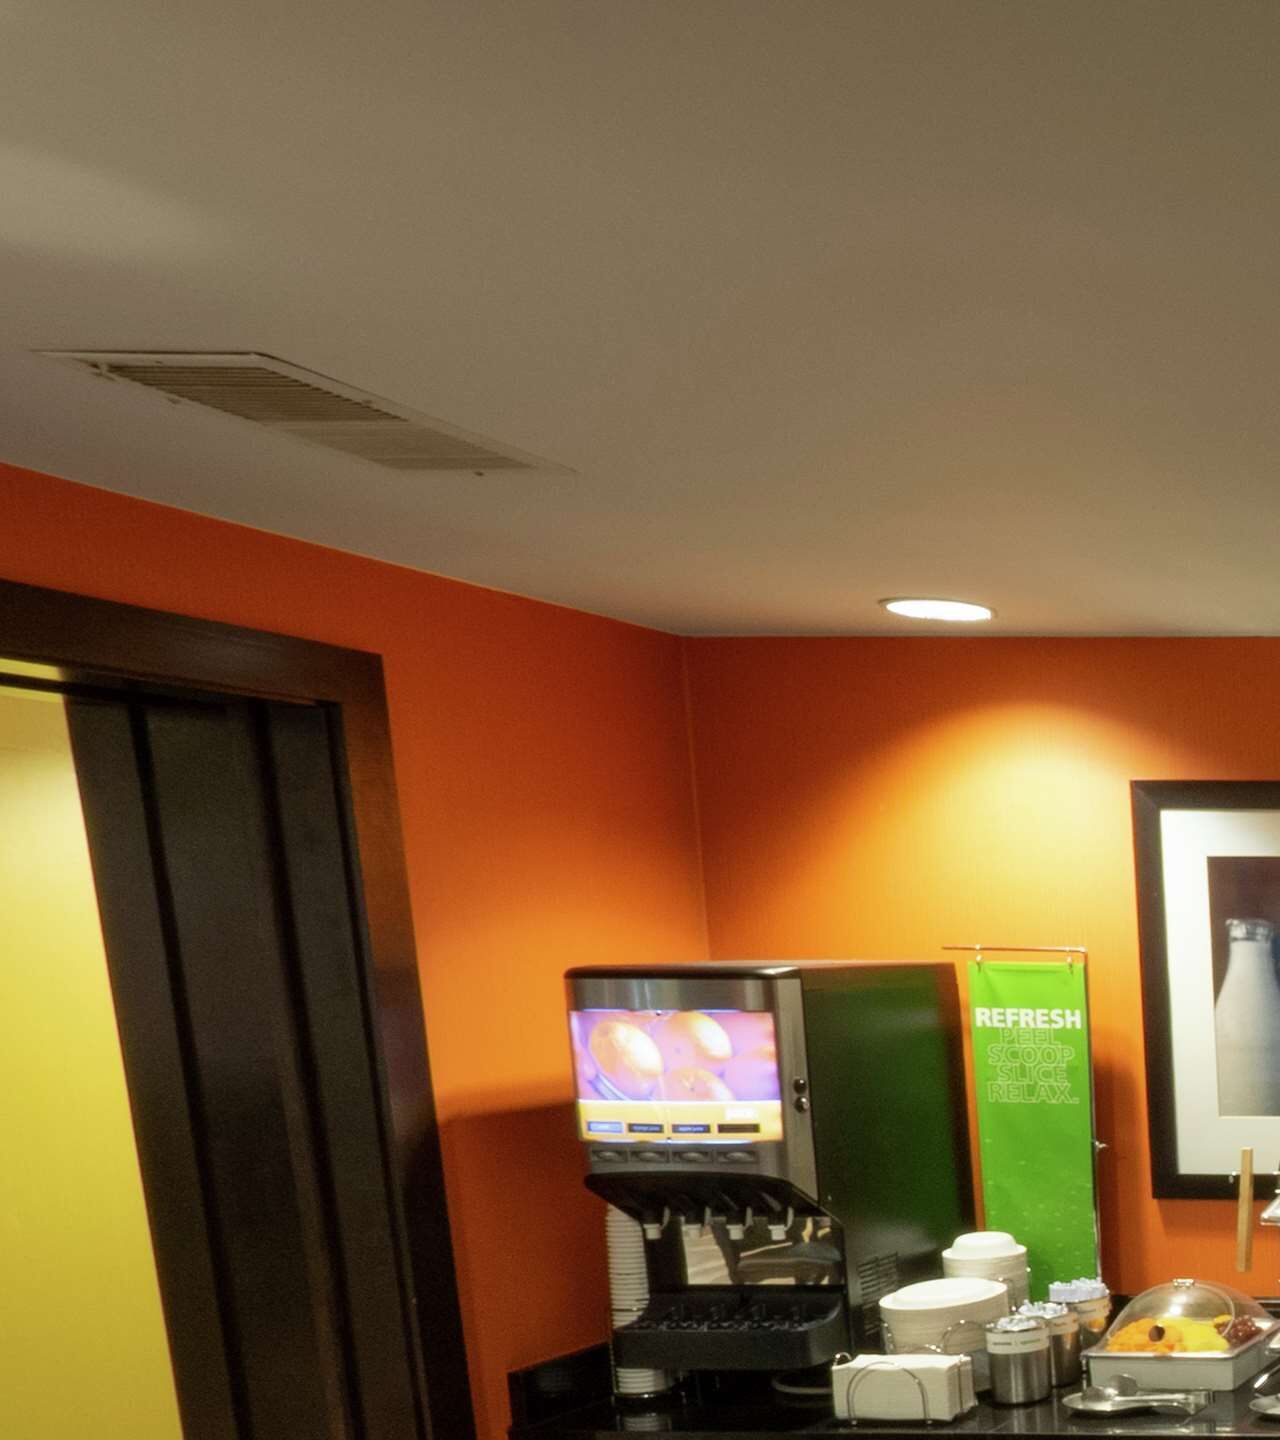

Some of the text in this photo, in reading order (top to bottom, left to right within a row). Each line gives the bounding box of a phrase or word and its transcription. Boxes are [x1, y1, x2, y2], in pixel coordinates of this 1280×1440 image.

[975, 1007, 1081, 1029] REFRESH
[1000, 1027, 1061, 1045] PEEL
[987, 1043, 1075, 1067] SCOOP
[996, 1063, 1069, 1084] SLICE
[987, 1080, 1080, 1104] RELAX.
